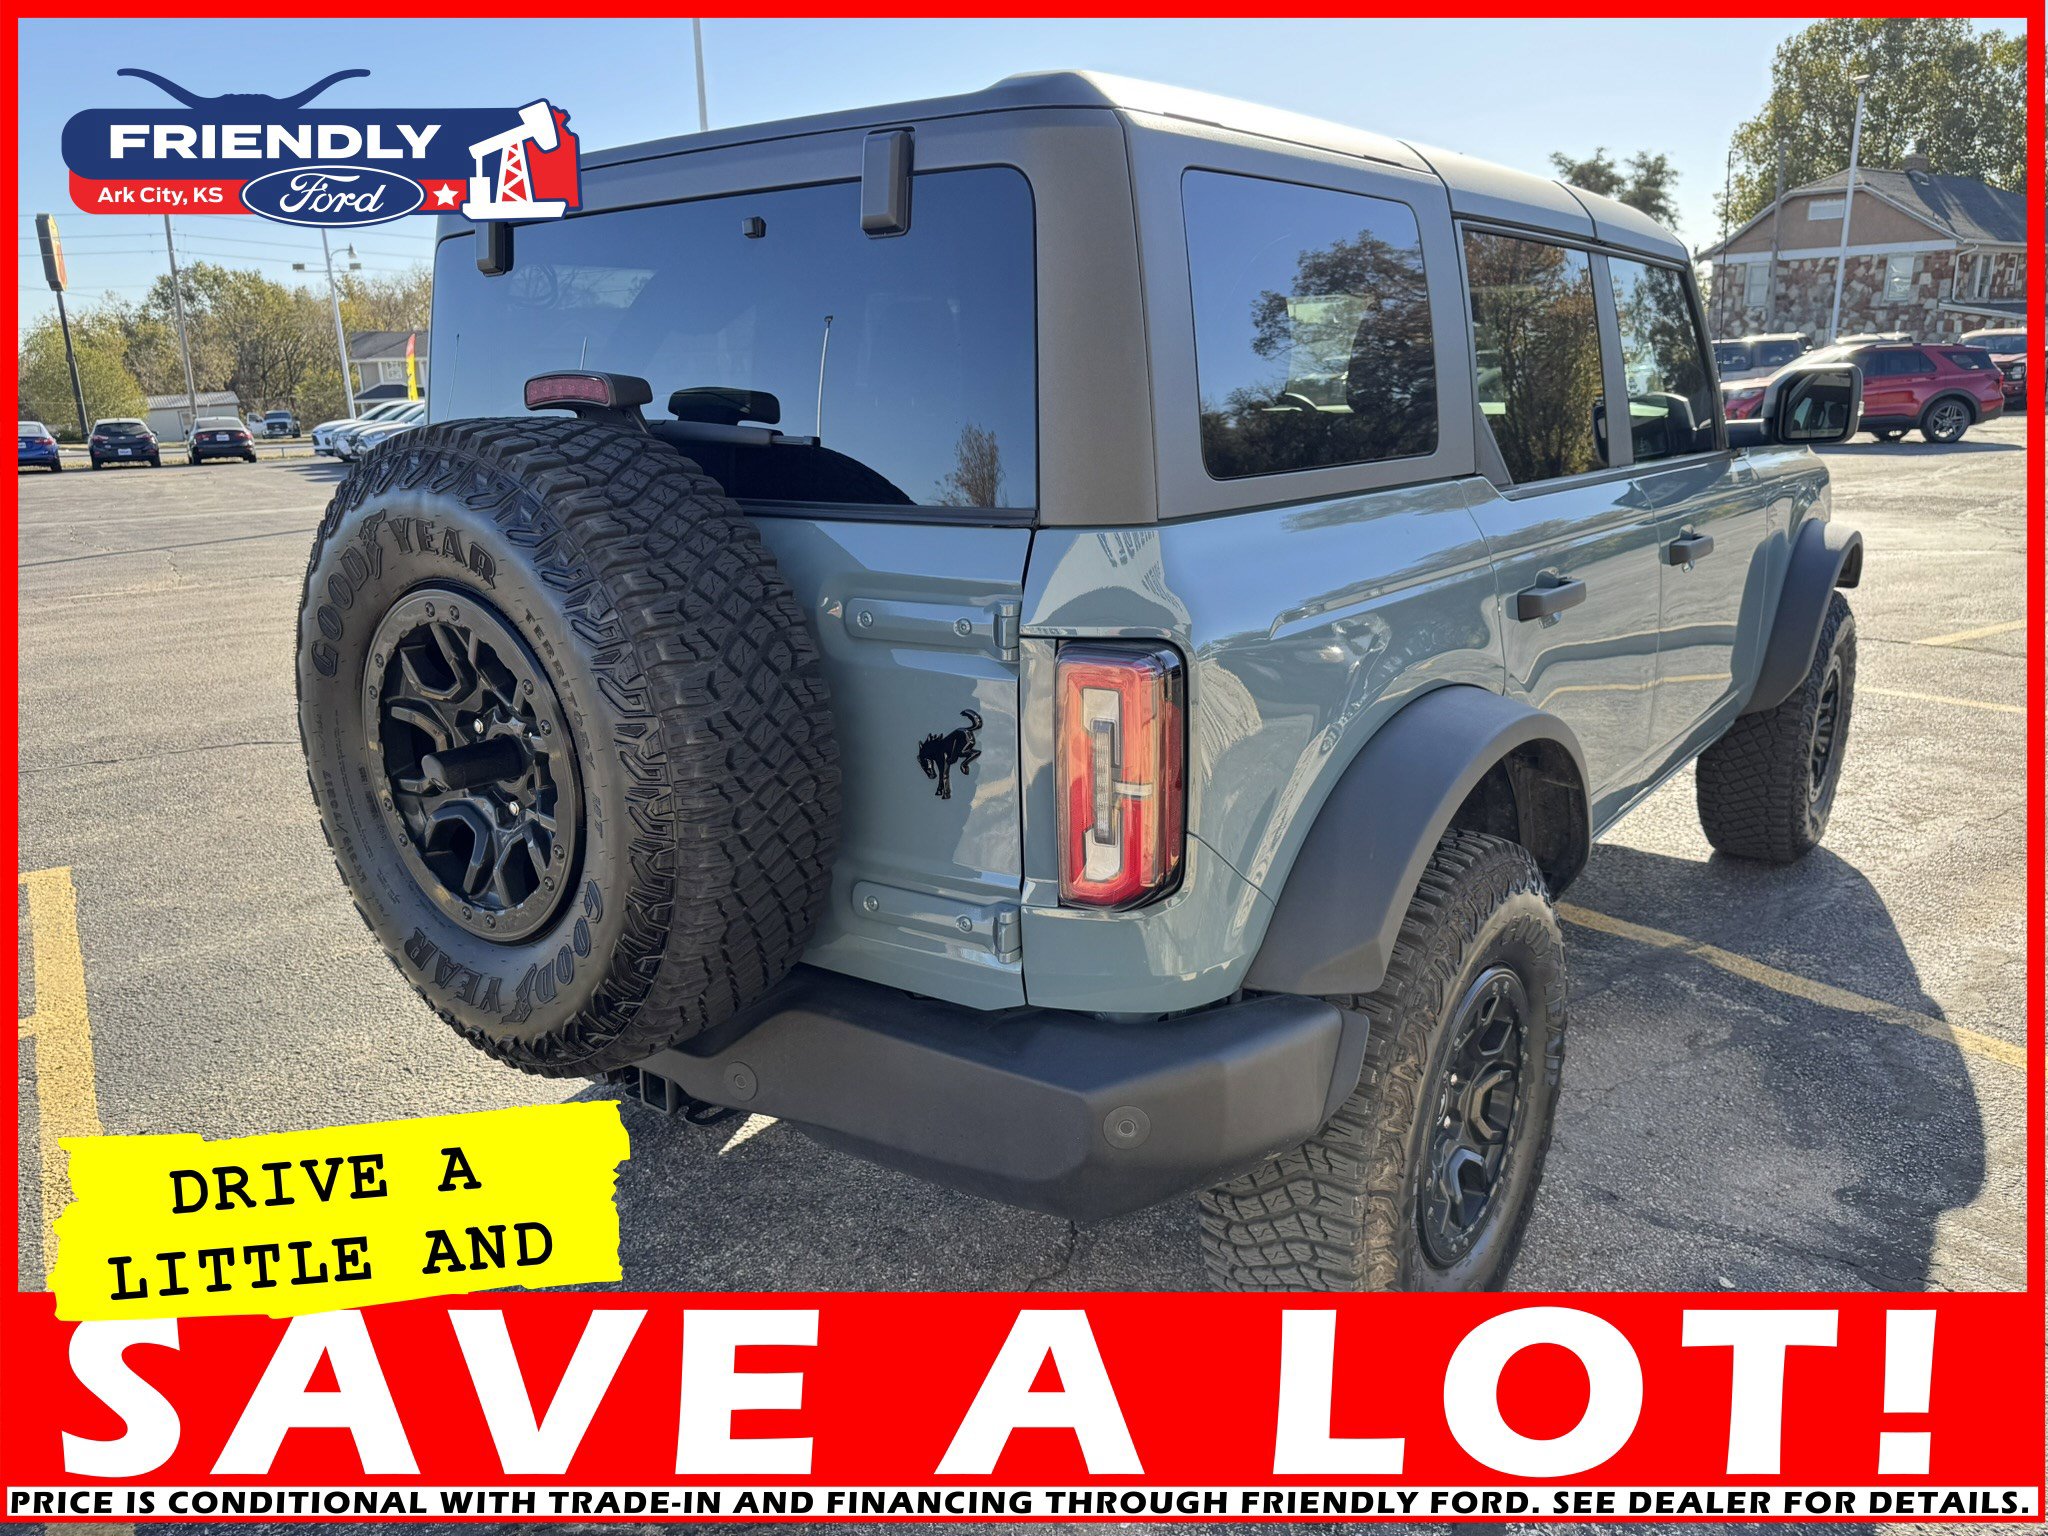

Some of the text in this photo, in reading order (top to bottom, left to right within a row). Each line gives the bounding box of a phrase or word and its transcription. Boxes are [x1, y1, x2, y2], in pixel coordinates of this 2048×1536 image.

[311, 508, 496, 678] GOODYEAR
[525, 608, 596, 770] TERRITORY
[403, 879, 603, 1025] GOODYEAR
